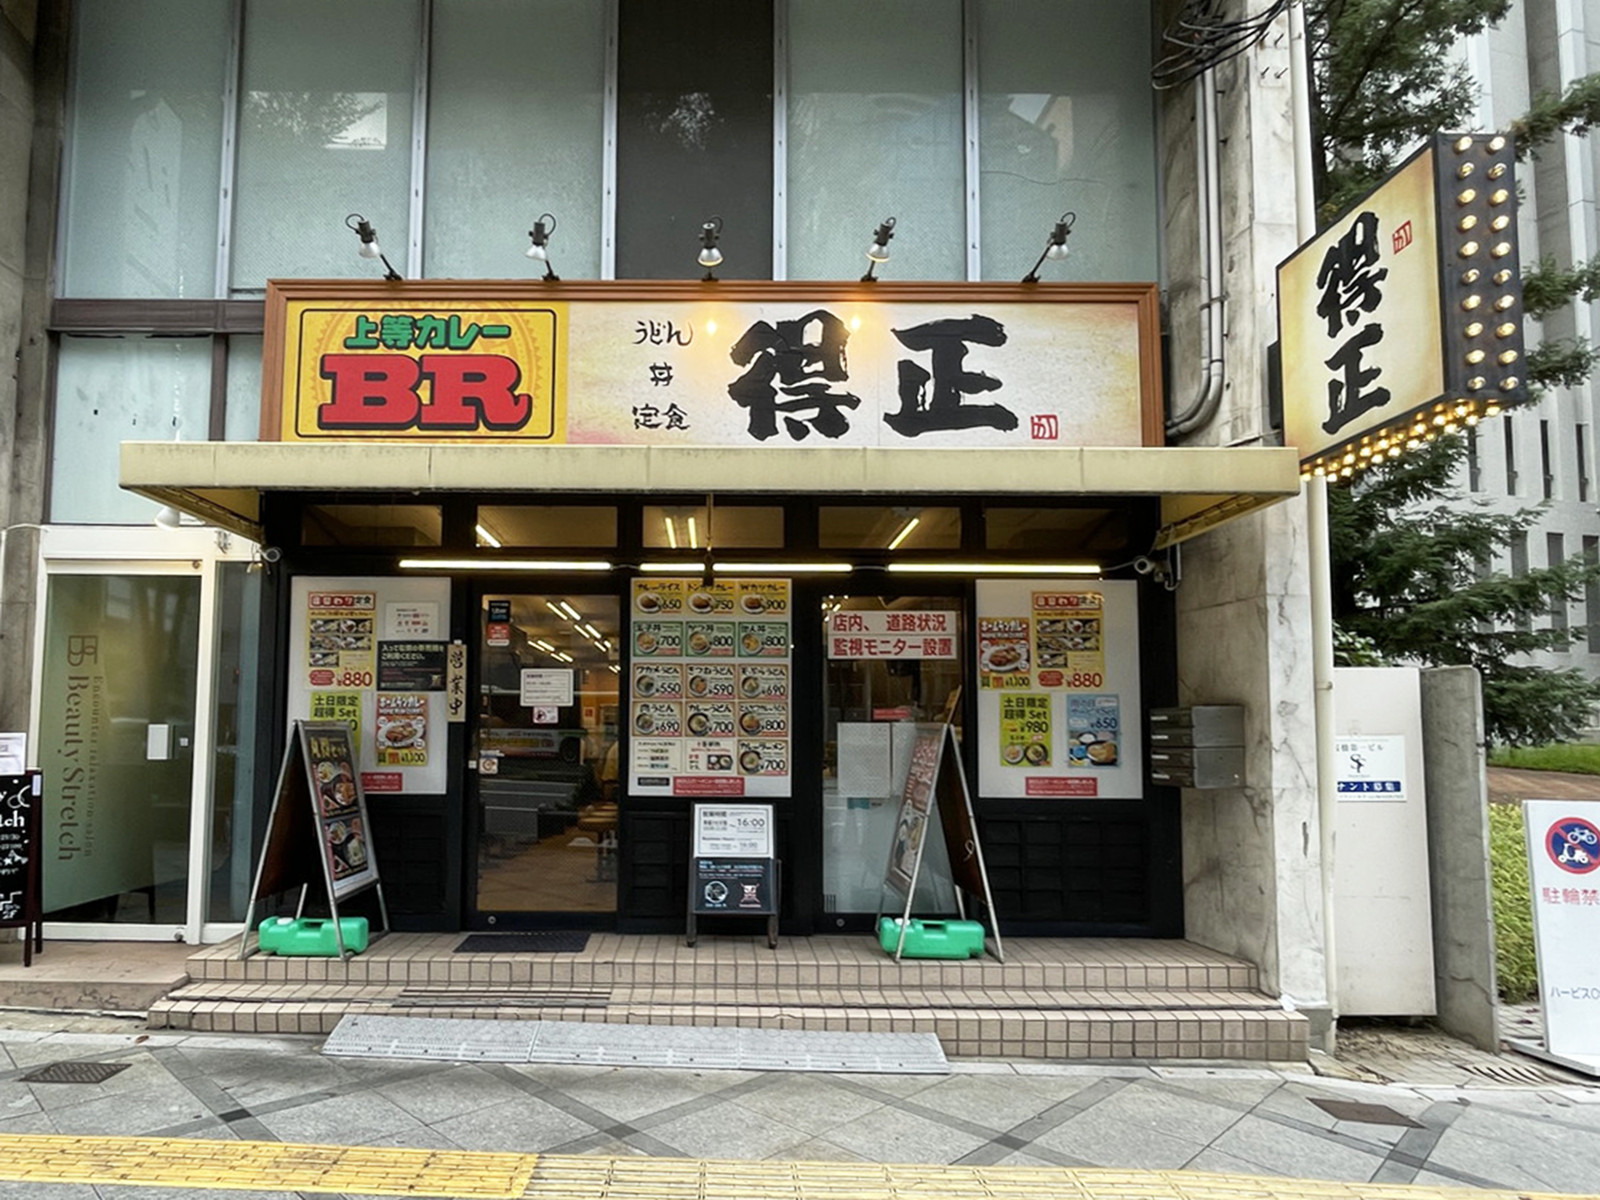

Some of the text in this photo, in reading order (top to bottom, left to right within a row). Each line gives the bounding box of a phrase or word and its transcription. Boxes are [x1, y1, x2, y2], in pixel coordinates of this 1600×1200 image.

[344, 315, 511, 349] 上等カレー
[632, 320, 693, 346] うどん
[648, 361, 674, 387] 丼
[317, 353, 533, 431] BR
[632, 402, 690, 430] 定食
[886, 613, 946, 631] 道路状況
[833, 638, 953, 656] 監視モニター設置
[314, 695, 358, 706] 土日限定
[1004, 697, 1048, 709] 土日限定
[339, 708, 357, 717] Set
[1029, 710, 1047, 719] Set
[58, 675, 89, 861] Beauty Stretch
[737, 818, 765, 827] 16:00
